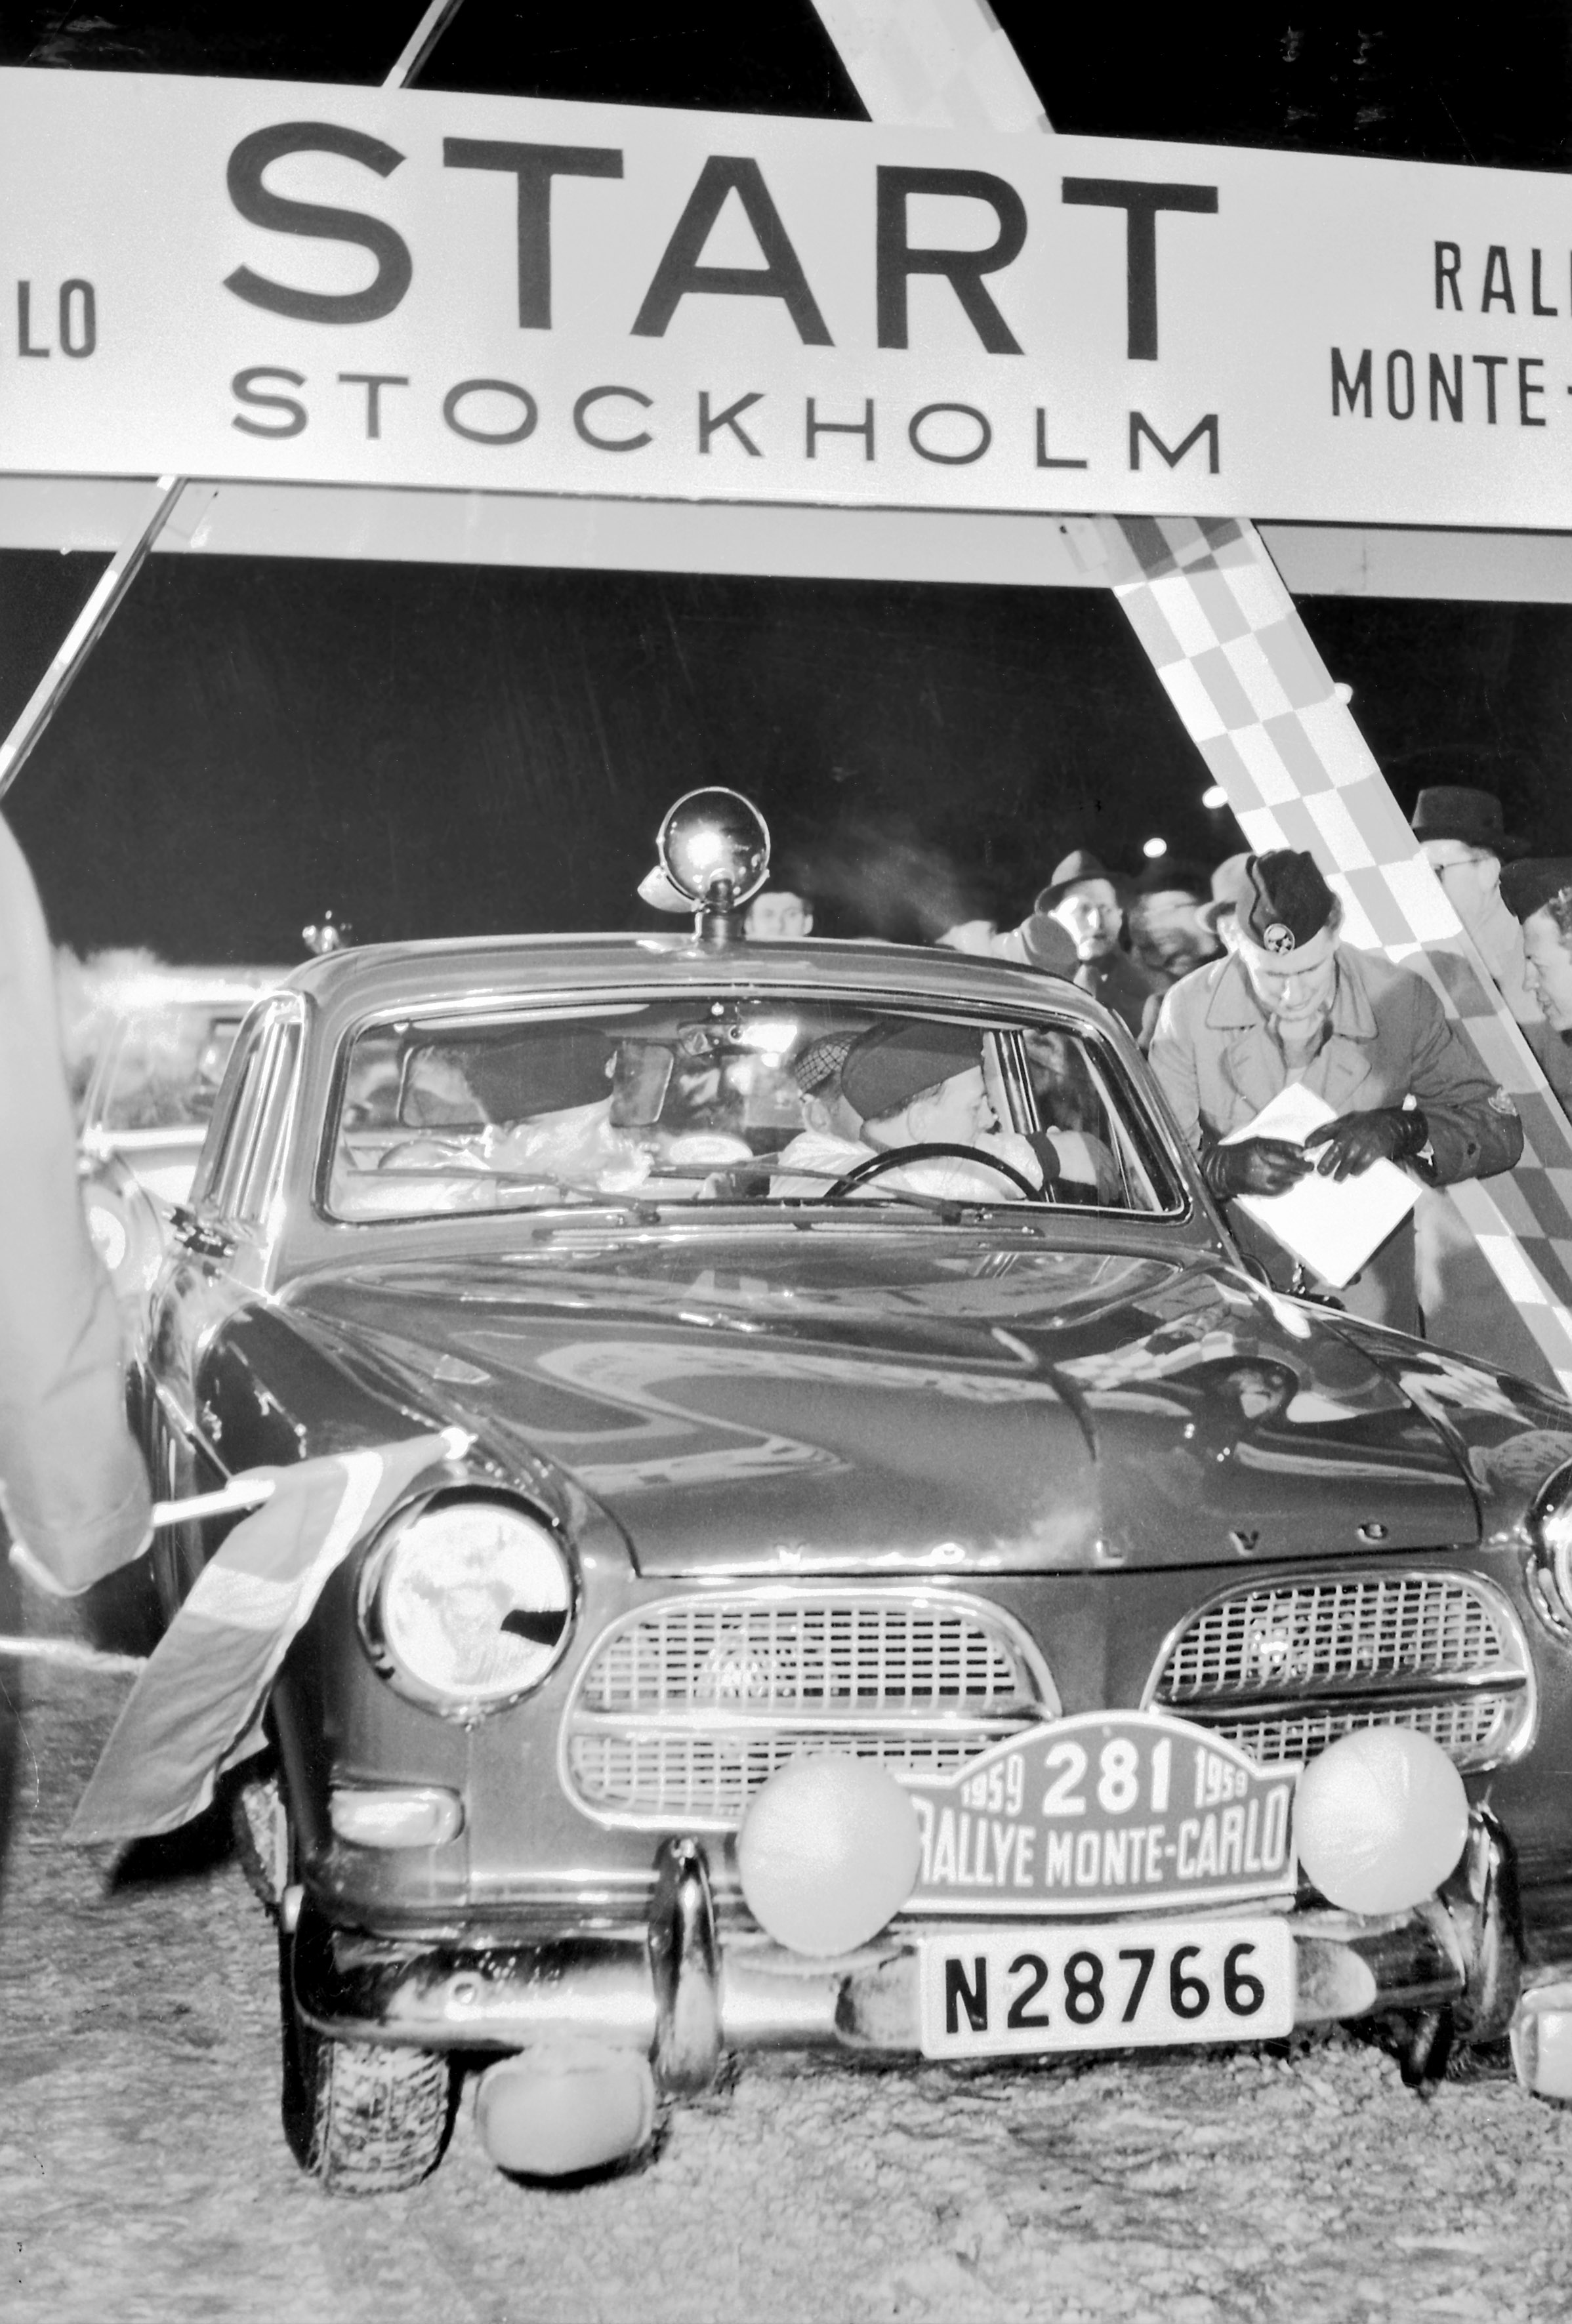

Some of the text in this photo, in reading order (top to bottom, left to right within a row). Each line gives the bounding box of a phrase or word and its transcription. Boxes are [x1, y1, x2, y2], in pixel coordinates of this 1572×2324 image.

[222, 121, 1219, 361] START
[1434, 239, 1572, 317] RAL
[17, 278, 96, 359] LO
[230, 365, 1220, 474] STOCKHOLM
[962, 1737, 1247, 1816] 1959 281 1959
[911, 1784, 1290, 1887] RALLYE MONTE-CARLO
